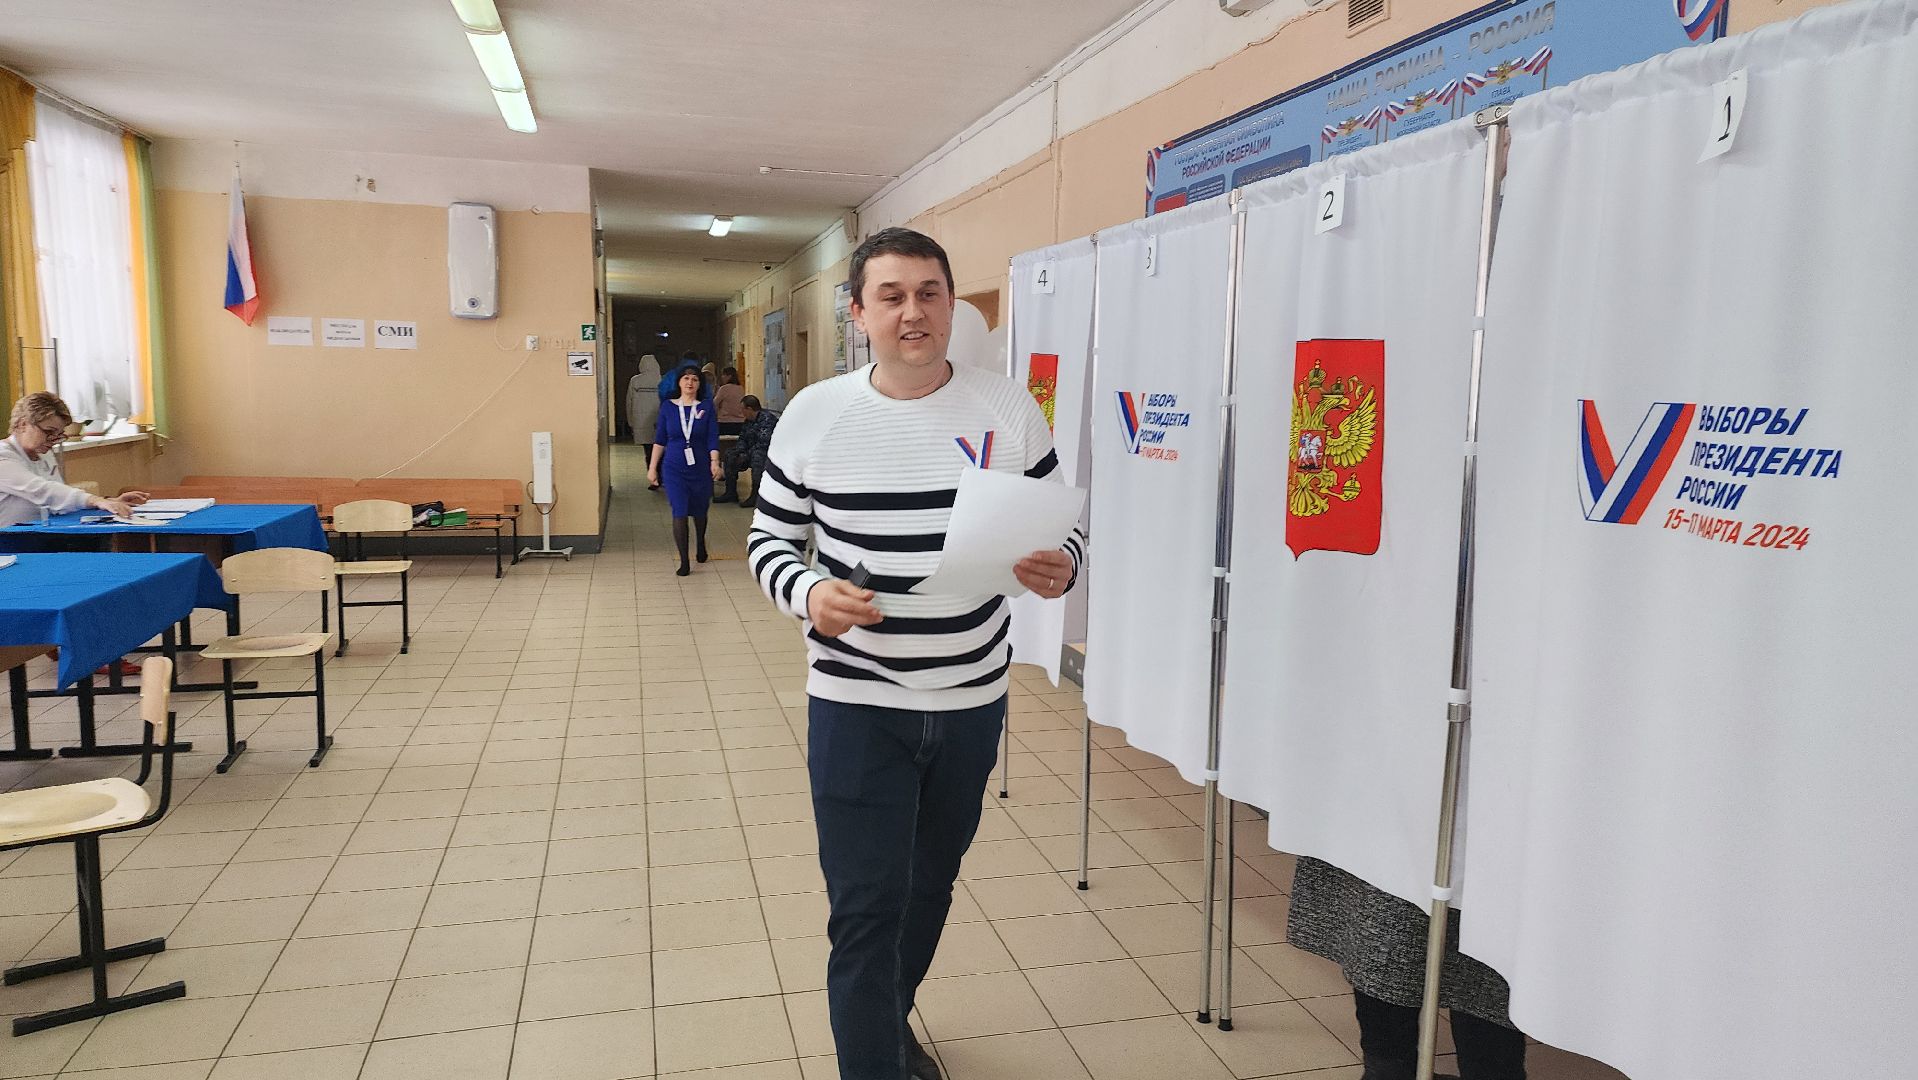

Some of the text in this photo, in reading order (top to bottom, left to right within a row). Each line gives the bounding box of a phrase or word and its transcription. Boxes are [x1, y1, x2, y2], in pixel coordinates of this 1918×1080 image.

[1373, 46, 1446, 96] РОДИНА
[1468, 1, 1556, 60] РОССИЯ
[1717, 95, 1732, 142] 1
[1181, 152, 1225, 180] РОССИЙСКОЙ
[1225, 135, 1272, 165] ФЕДЕРАЦИИ
[1322, 190, 1335, 221] 2
[1037, 269, 1049, 287] 4
[377, 325, 414, 338] СМИ
[1698, 405, 1809, 436] ВЫБОРЫ
[1689, 441, 1843, 479] ПРЕЗИДЕНТА
[1676, 476, 1748, 511] РОССИИ
[1698, 514, 1743, 545] МАРТА
[1742, 523, 1811, 551] 2024
